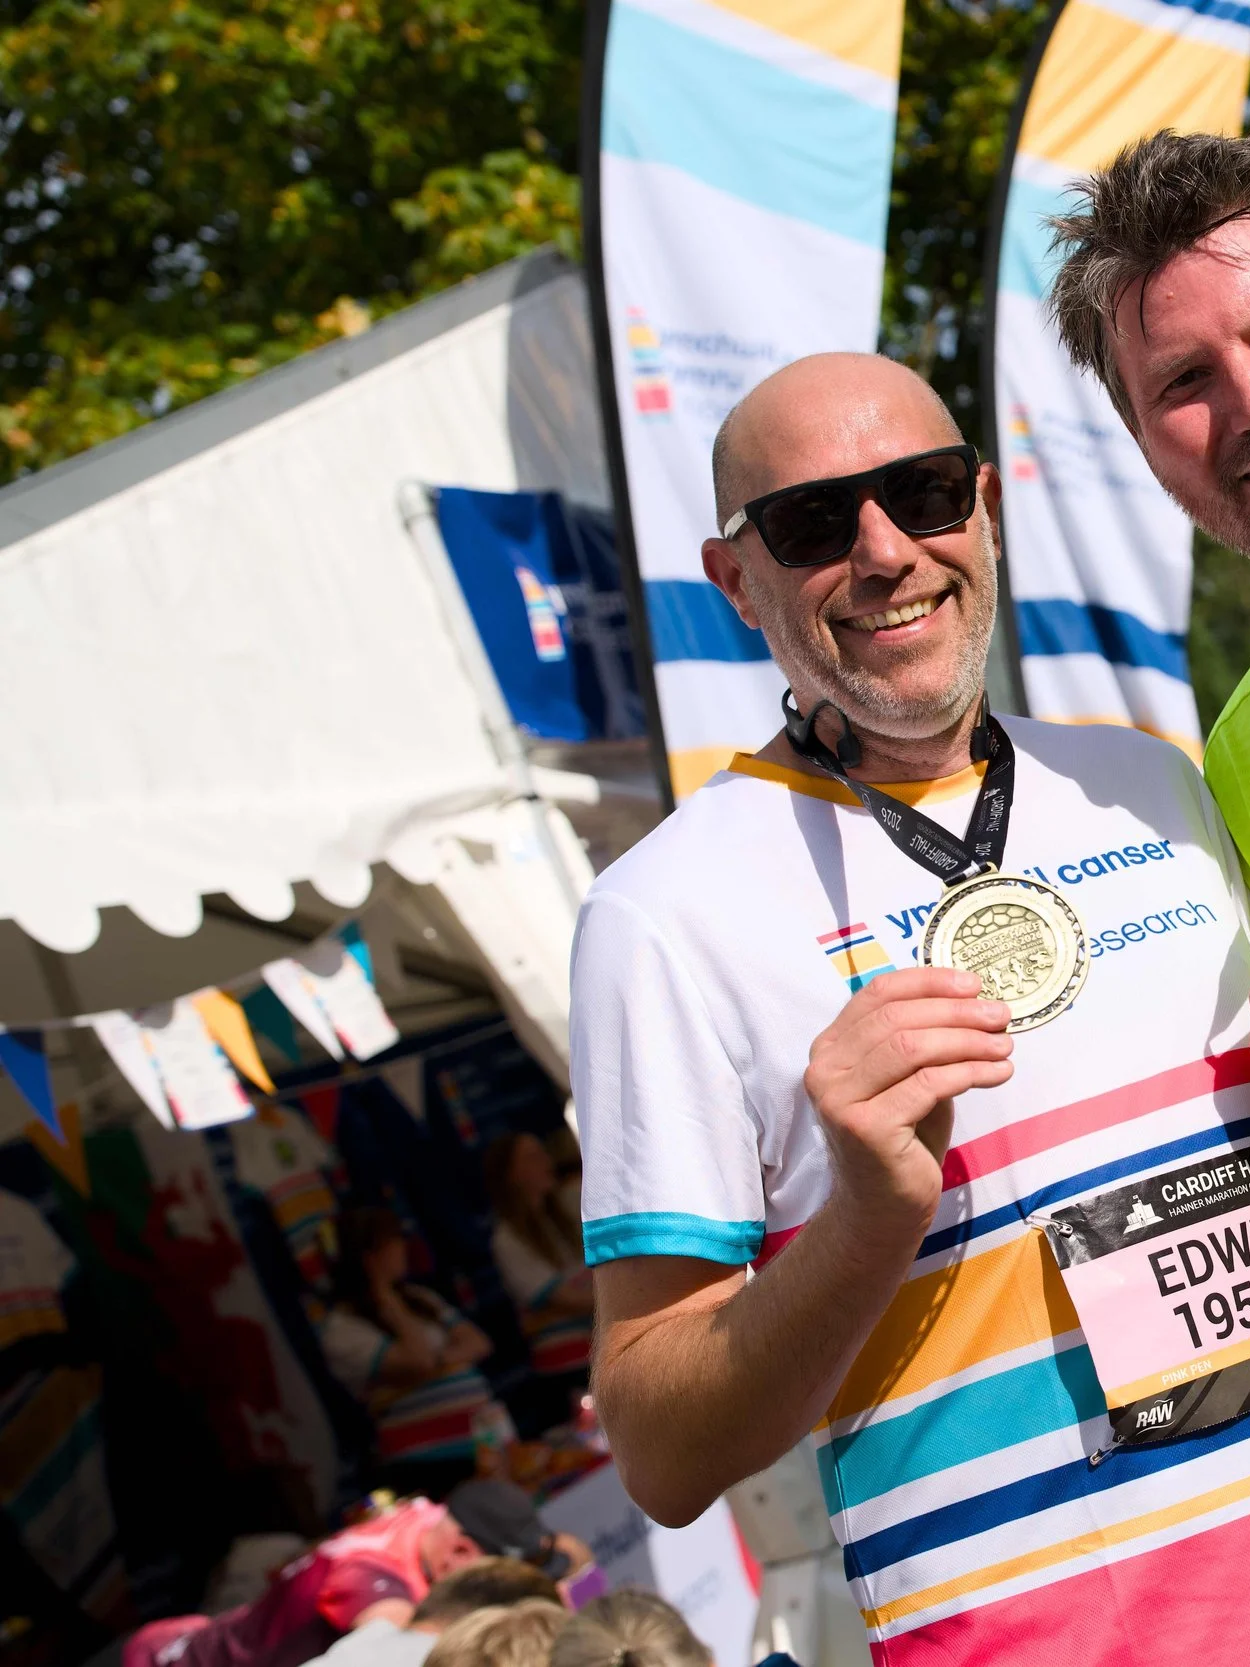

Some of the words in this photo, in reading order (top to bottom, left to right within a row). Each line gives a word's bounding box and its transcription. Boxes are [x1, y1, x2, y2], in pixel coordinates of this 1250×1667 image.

[880, 807, 902, 831] 2026
[908, 833, 930, 855] HALF
[924, 845, 959, 871] CARDIFF
[1057, 839, 1176, 885] canser
[1089, 900, 1217, 958] esearch
[959, 931, 1010, 961] CARDIFF
[1161, 1163, 1236, 1203] CARDIFF
[1169, 1198, 1205, 1218] HANNER
[1204, 1186, 1249, 1207] MARATHON
[1161, 1369, 1189, 1386] PINK
[1190, 1360, 1212, 1376] PEN
[1136, 1401, 1174, 1429] R4W
